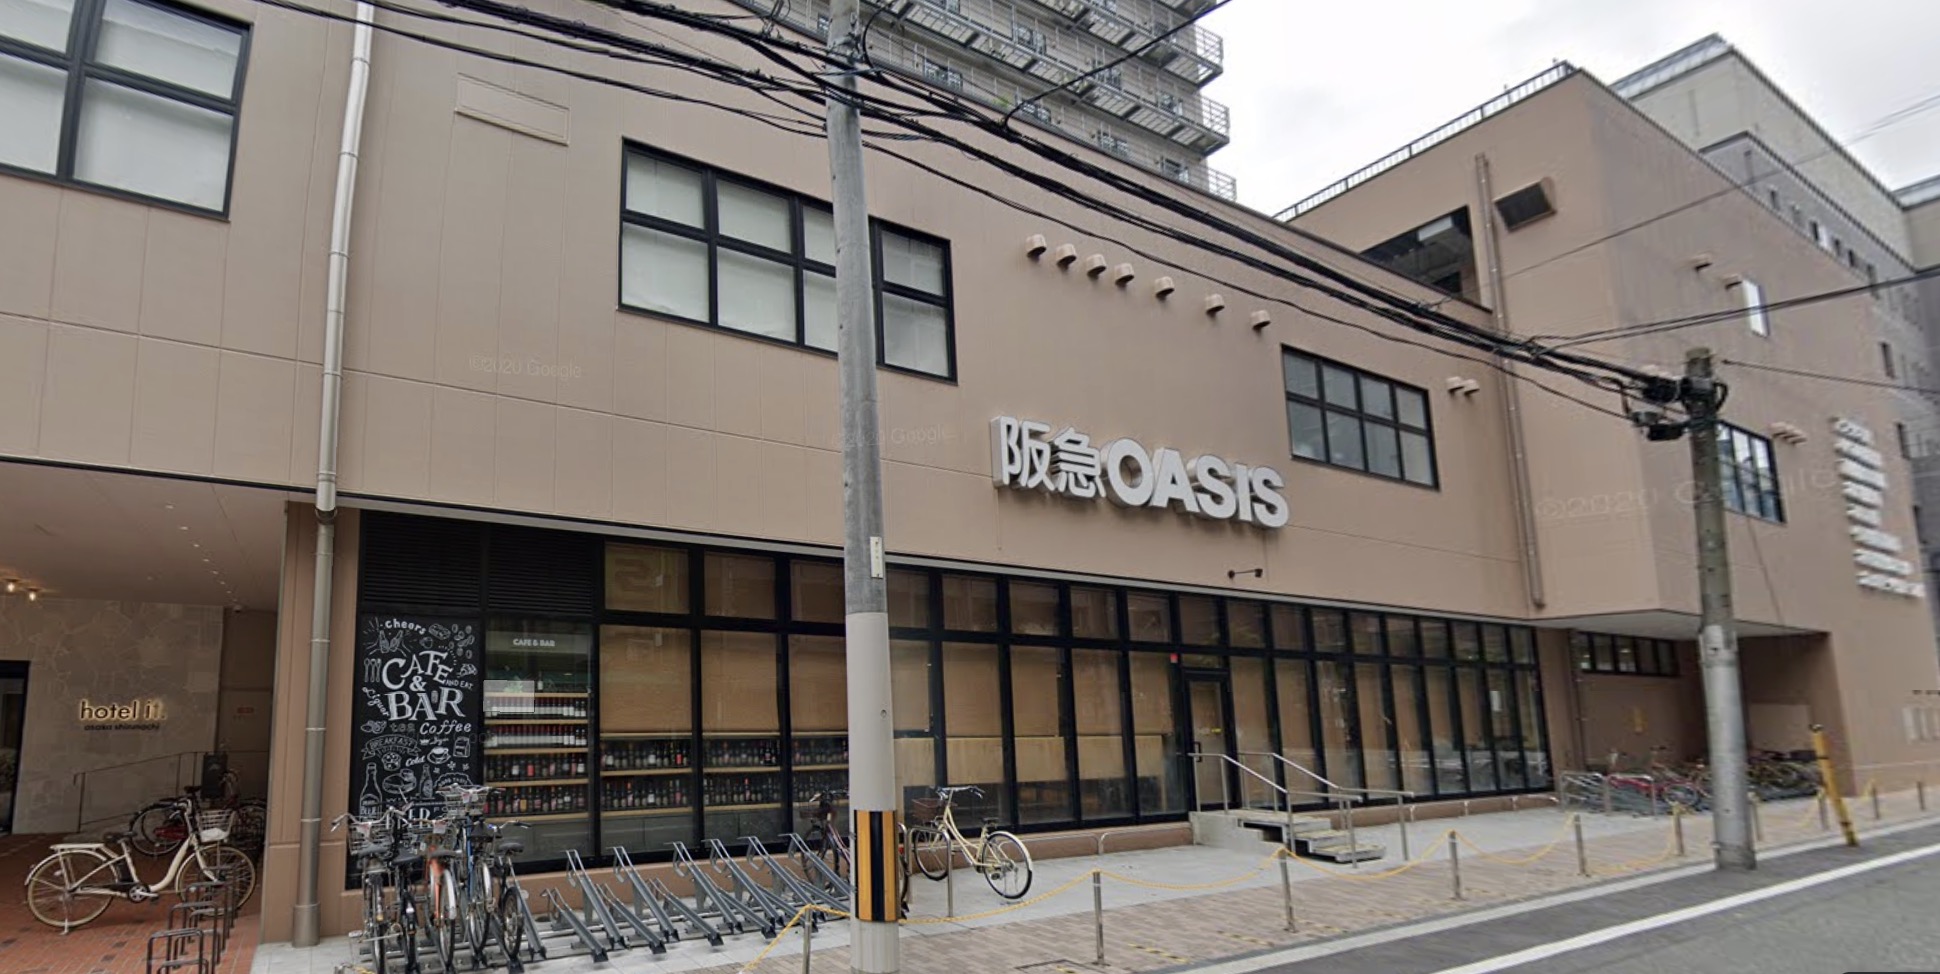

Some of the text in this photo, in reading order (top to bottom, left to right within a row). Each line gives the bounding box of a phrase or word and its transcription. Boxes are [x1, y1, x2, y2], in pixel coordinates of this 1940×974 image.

[991, 415, 1289, 528] 阪急OASIS
[512, 637, 532, 647] CAFE
[540, 638, 556, 647] BAR
[381, 650, 454, 691] CAFE
[409, 675, 428, 692] &
[79, 699, 138, 720] hotel
[384, 686, 466, 721] BAR
[419, 719, 472, 735] Coffee
